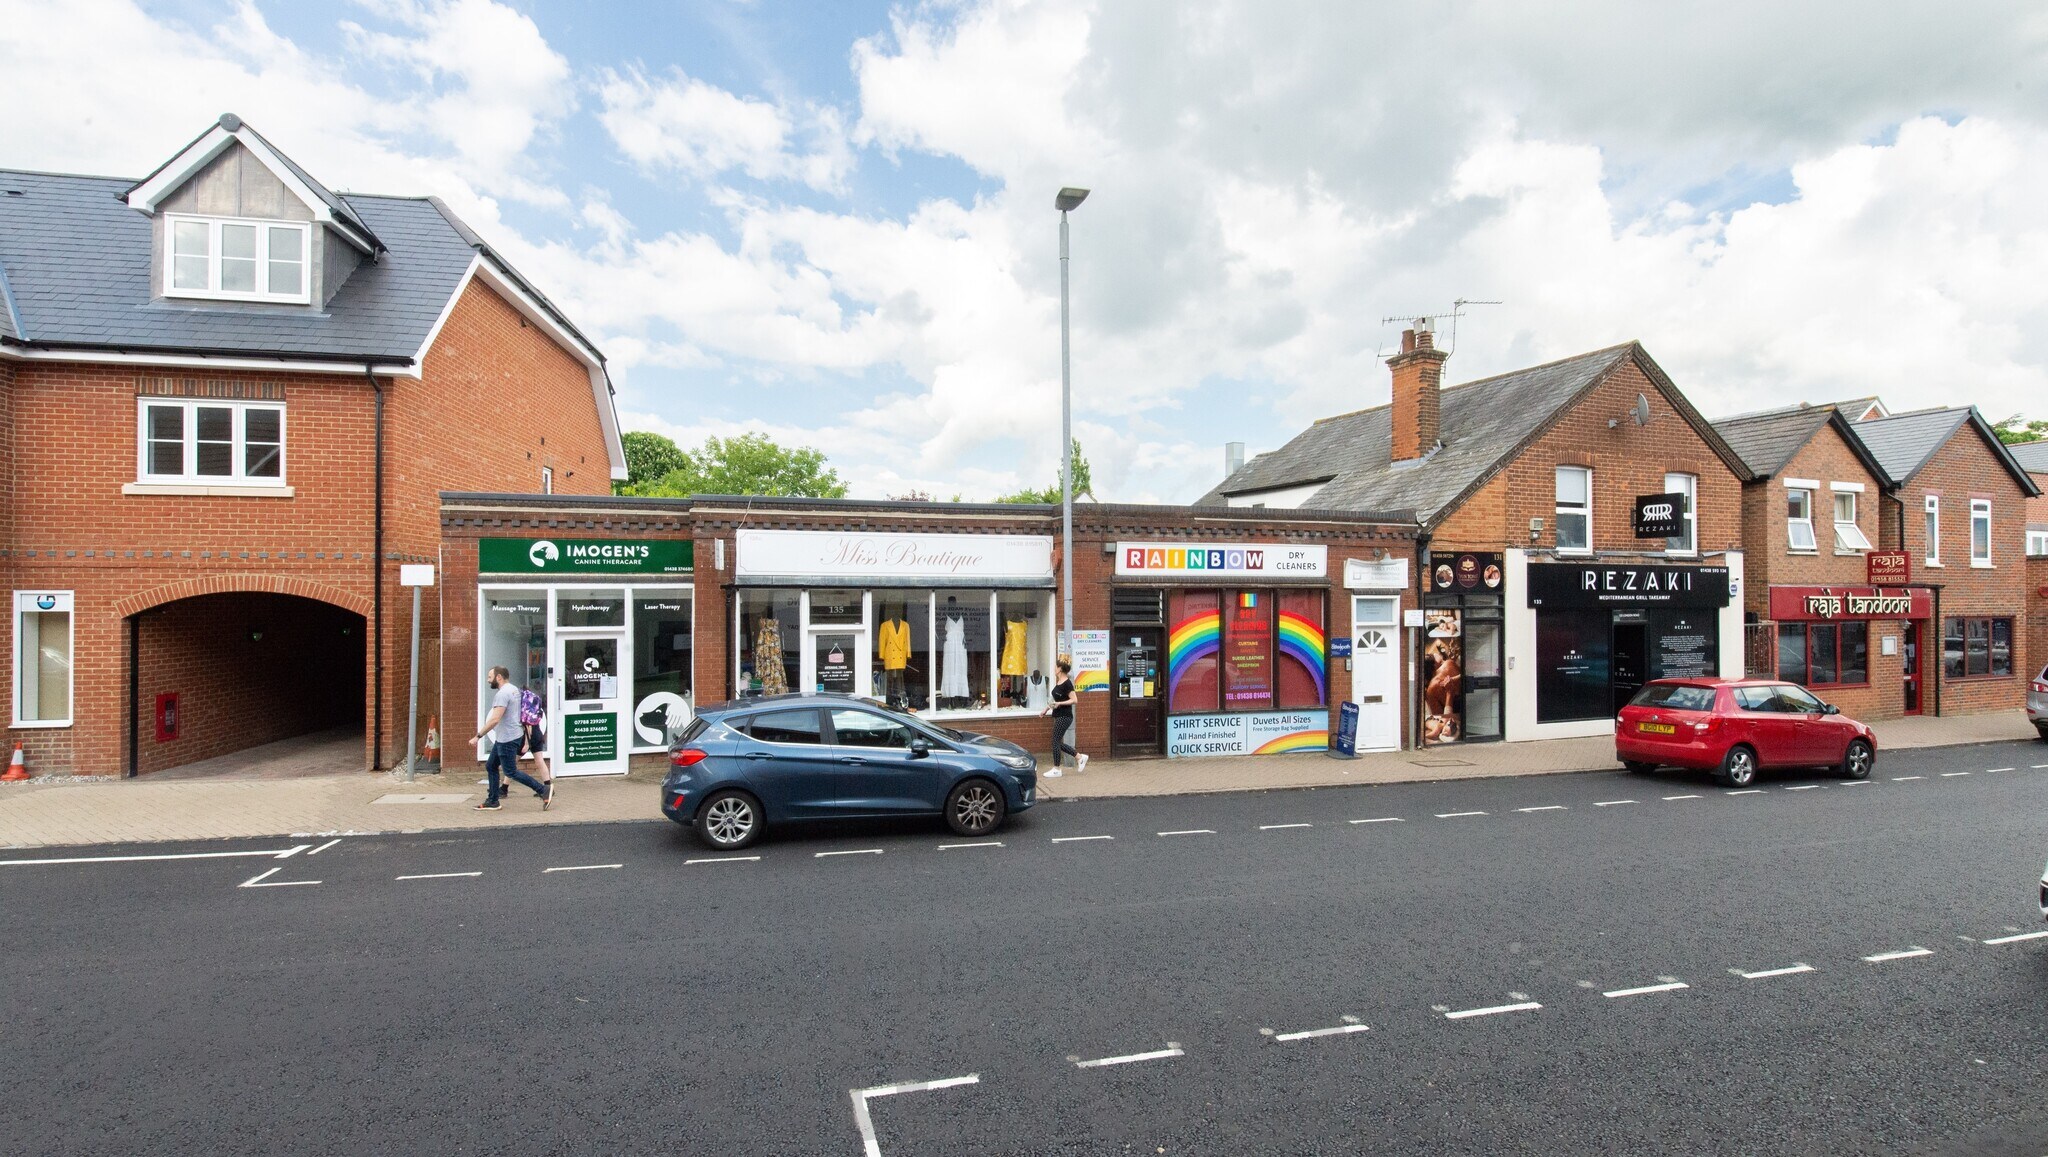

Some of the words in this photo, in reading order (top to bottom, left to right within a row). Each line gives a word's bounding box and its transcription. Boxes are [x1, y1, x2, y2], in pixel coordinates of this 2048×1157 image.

[567, 545, 649, 557] IMOGEN'S
[820, 537, 877, 566] Miss
[885, 538, 982, 572] Boutique
[1289, 552, 1304, 560] DRY
[1130, 550, 1263, 568] RAINBOW
[1872, 552, 1905, 568] raja
[1277, 562, 1316, 570] CLEANERS
[1582, 571, 1690, 591] REZAKI
[492, 605, 516, 613] Massage
[517, 604, 540, 613] Therapy
[572, 604, 610, 612] Hydrotherapy
[659, 603, 681, 611] Therapy
[1806, 588, 1841, 619] raja
[1845, 588, 1912, 614] tandoori
[829, 606, 844, 614] 135
[1173, 718, 1201, 729] SHIRT
[1203, 717, 1241, 728] SERVICE
[1253, 716, 1279, 725] Duvets
[1281, 715, 1292, 724] All
[1294, 715, 1311, 724] Sizes
[1188, 732, 1206, 740] Hand
[1208, 731, 1236, 739] Finished
[1171, 744, 1202, 755] QUICK
[1204, 742, 1242, 752] SERVICE
